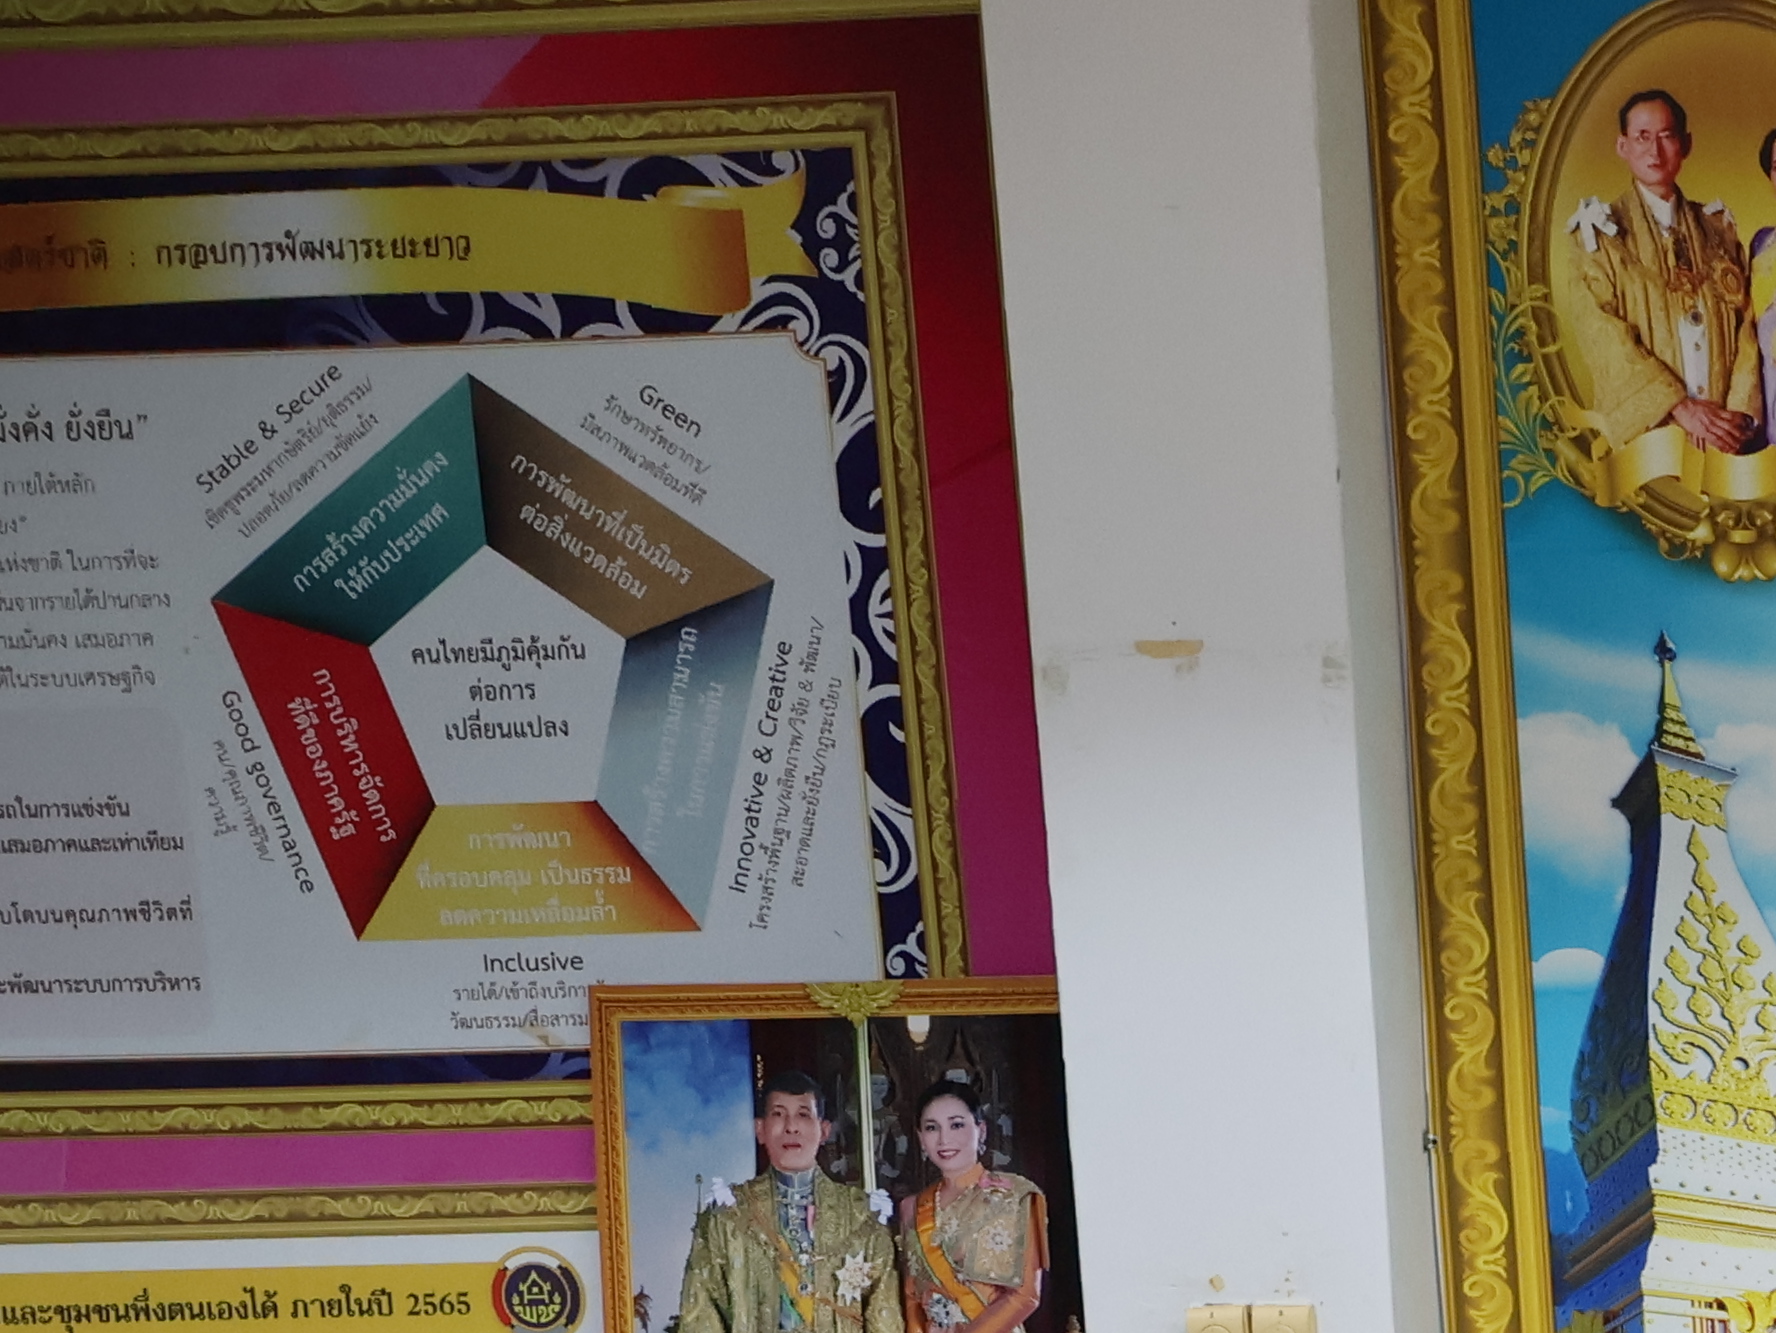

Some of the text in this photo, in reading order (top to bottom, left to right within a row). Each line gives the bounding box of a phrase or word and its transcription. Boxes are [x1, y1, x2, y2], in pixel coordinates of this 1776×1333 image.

[156, 229, 471, 270] กรอบการพัฒนาระยะยาว
[195, 364, 342, 494] Stable & Secure
[639, 384, 702, 438] Green
[293, 451, 449, 593] การสร้างความมั่นคง
[333, 501, 450, 600] ให้กับประเทศ
[510, 454, 693, 585] การพัฒนาที่เป็นมิตร
[519, 502, 648, 599] ต่อสิ่งแวดล้อม
[411, 634, 587, 671] คนไทยมีภูมิคุ้มกัน
[468, 677, 537, 702] ต่อการ
[313, 668, 397, 843] การบริหารจัดการ
[444, 708, 570, 742] เปลี่ยนแปลง
[222, 690, 315, 894] Good governance
[287, 696, 360, 841] ที่ดีของภาครัฐ
[728, 640, 793, 894] Innovative & Creative
[540, 859, 632, 887] เป็นธรรม
[452, 981, 589, 1003] รายได้/เข้าถึงบริกา
[482, 951, 585, 975] Inclusive
[291, 1284, 394, 1319] ภายในปี
[406, 1291, 471, 1316] 2565
